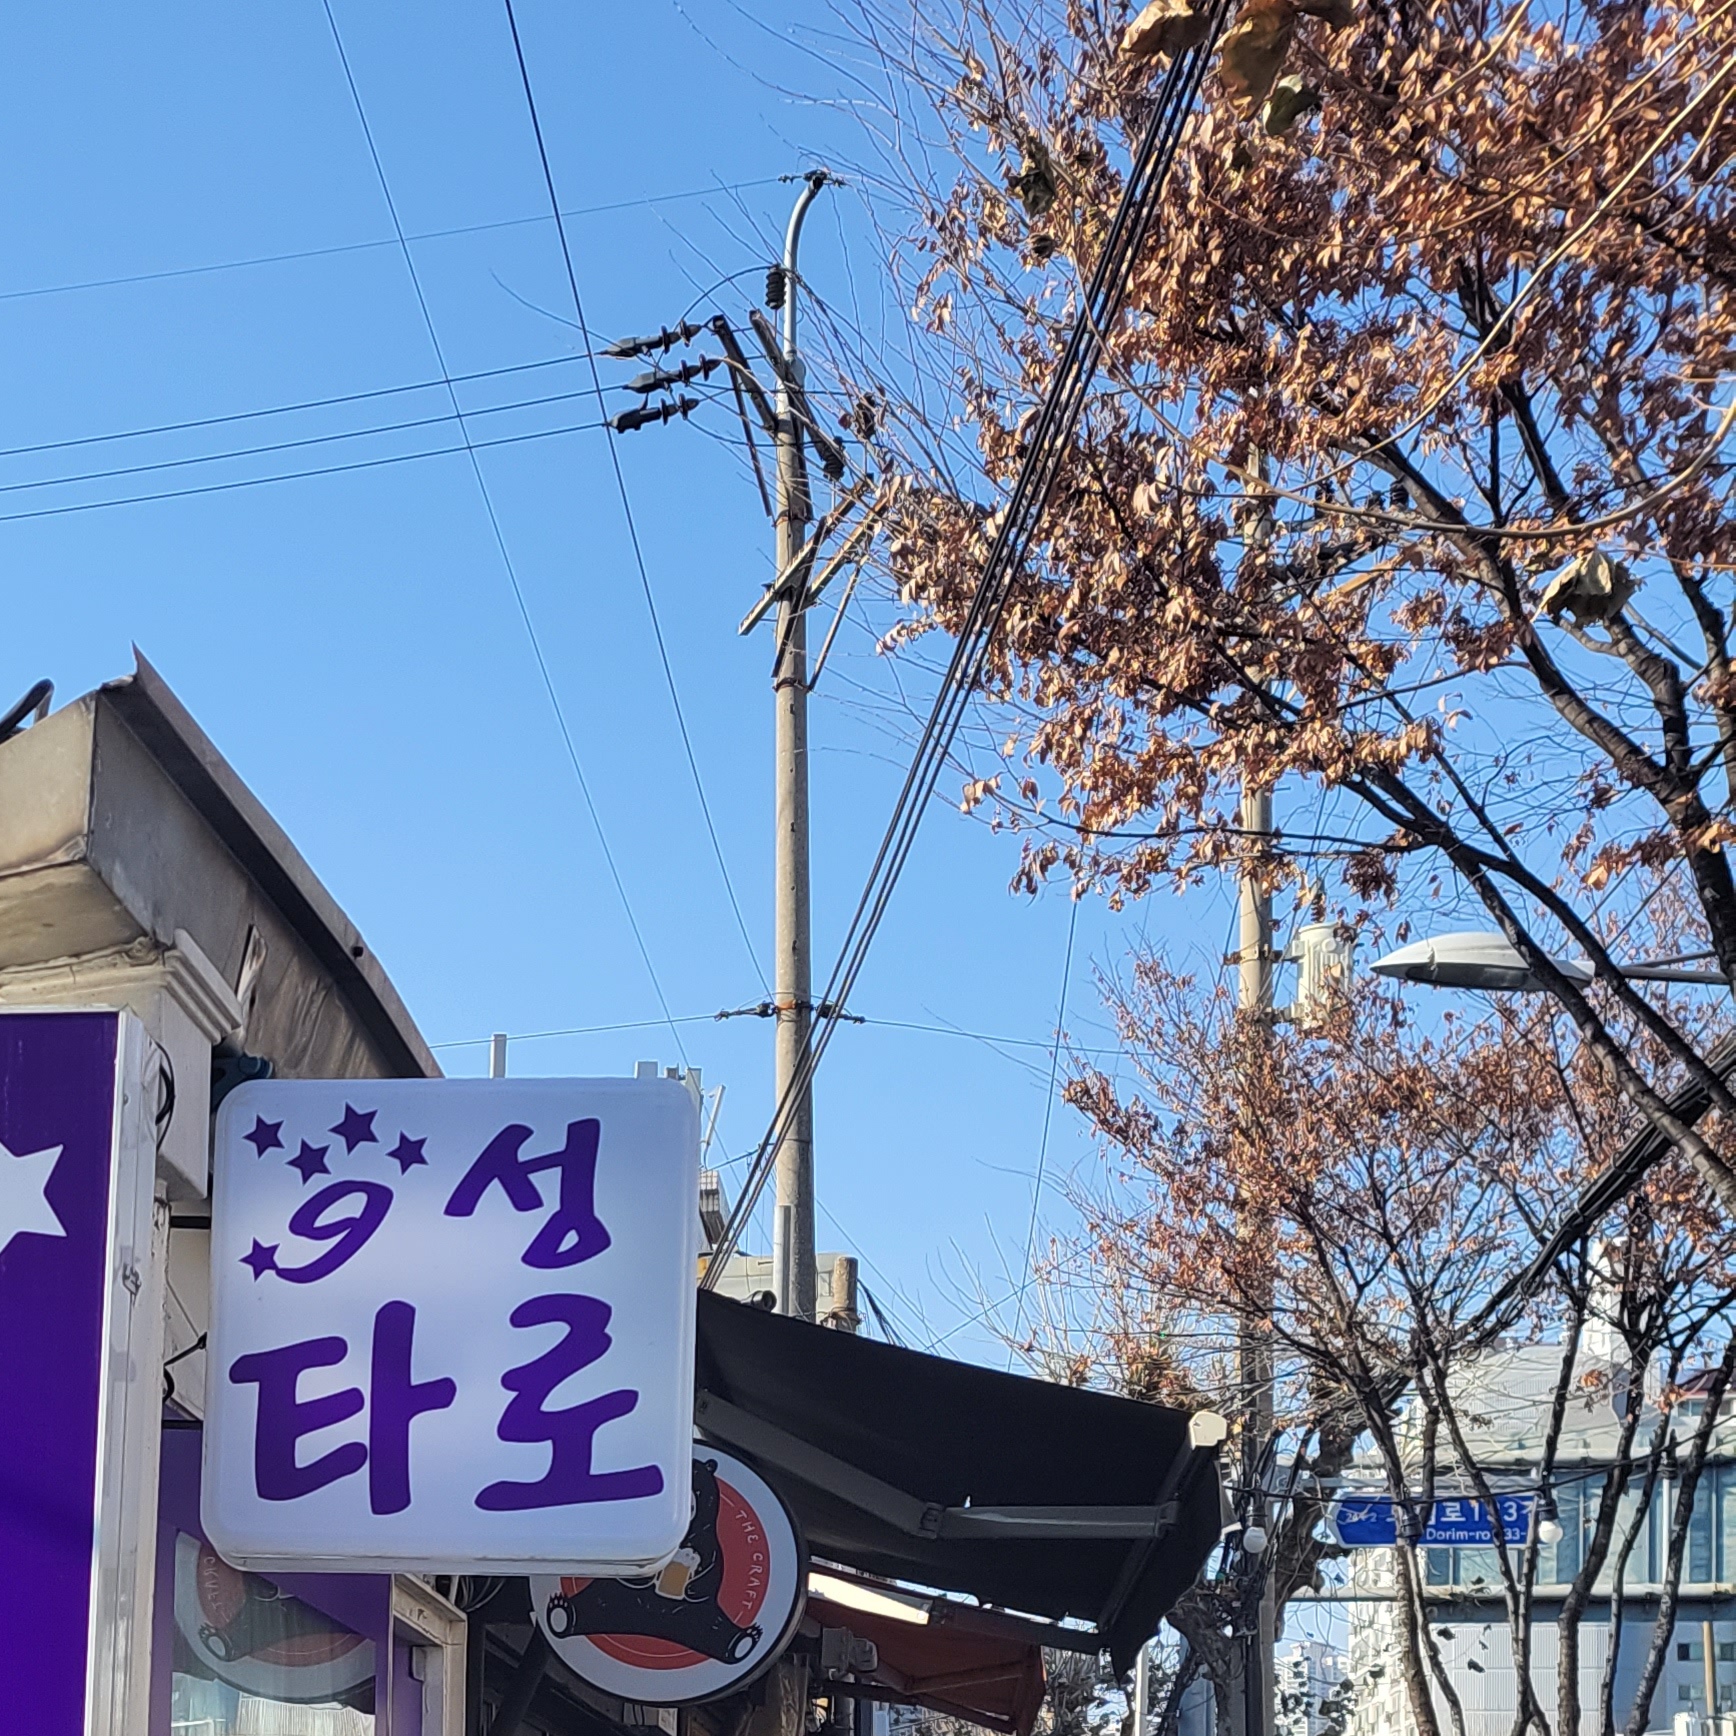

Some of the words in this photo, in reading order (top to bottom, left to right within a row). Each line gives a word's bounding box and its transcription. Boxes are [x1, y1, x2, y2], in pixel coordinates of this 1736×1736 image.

[228, 1293, 665, 1516] 타로
[735, 1509, 759, 1544] THE
[1425, 1527, 1492, 1541] Dorim-ro
[741, 1552, 764, 1610] CRAFT
